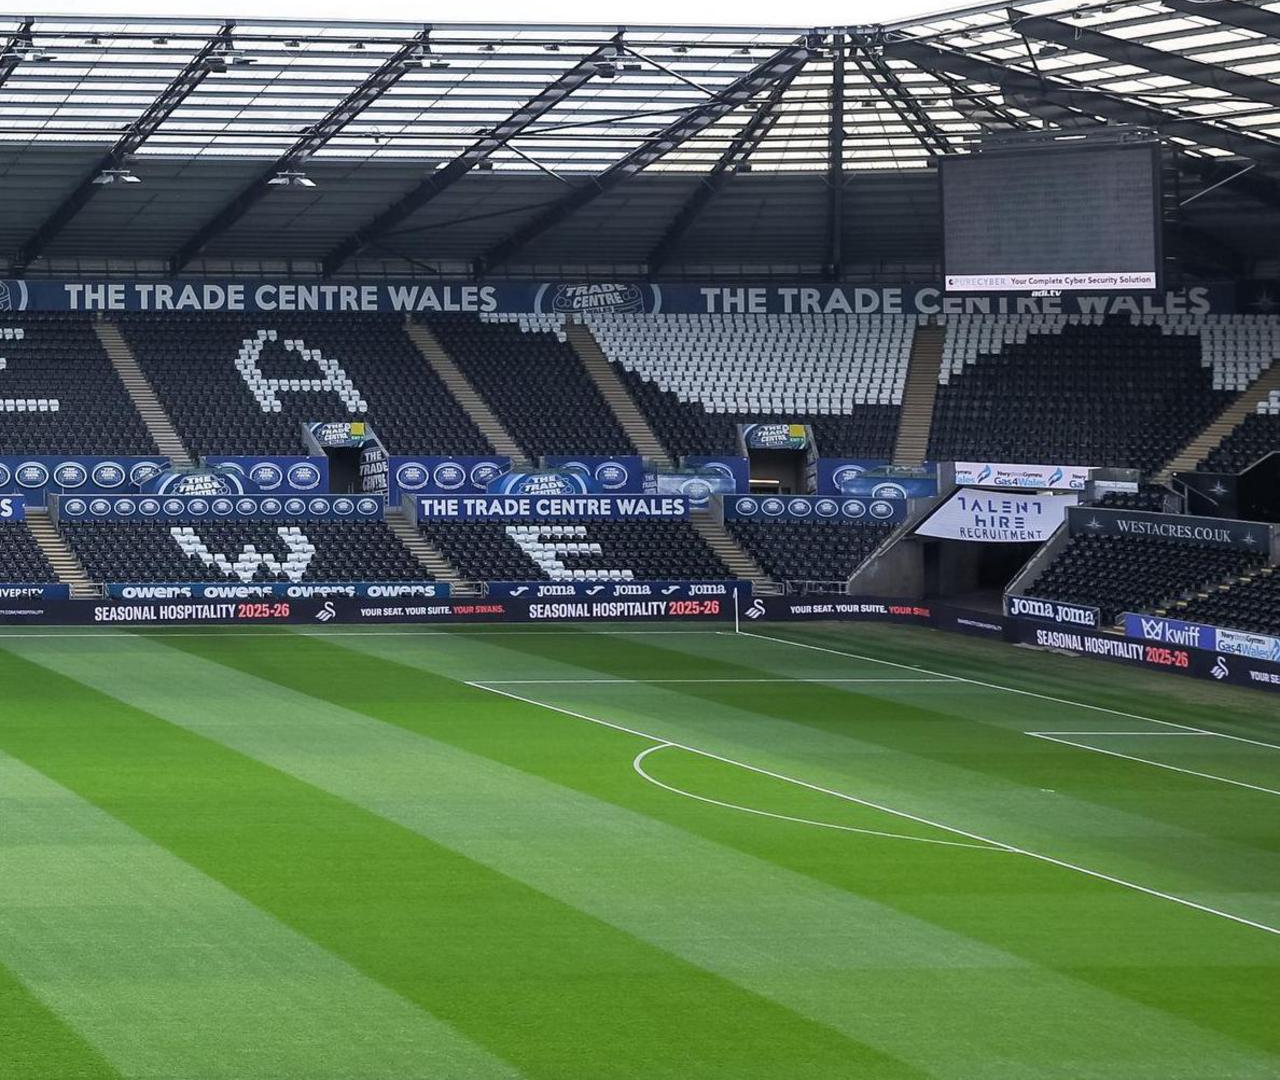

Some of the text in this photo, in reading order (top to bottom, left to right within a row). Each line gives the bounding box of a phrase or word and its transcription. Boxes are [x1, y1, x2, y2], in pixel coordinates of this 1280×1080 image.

[1029, 277, 1062, 286] Complete
[1065, 277, 1086, 286] Cyber
[1088, 277, 1117, 285] Security
[1120, 276, 1151, 284] Solution
[65, 285, 497, 312] THE TRADE CENTRE WALES
[566, 284, 627, 297] TRADE
[572, 293, 623, 309] CENTRE
[700, 288, 766, 312] THE
[778, 288, 902, 313] TRADE
[421, 498, 684, 516] THE TRADE CENTRE WALES
[975, 514, 1024, 529] HIRE
[960, 527, 1042, 540] RECRUITMENT
[1117, 520, 1231, 542] WESTACRES.CO.UK
[122, 587, 192, 598] owens
[95, 604, 289, 620] SEASONAL HOSPITALITY 2025-26
[361, 606, 452, 616] YOUR SEAT. YOUR SUITE.
[529, 600, 719, 618] SEASONAL HOSPITALITY 2025-26
[790, 604, 887, 614] YOUR SEAT. YOUR SUITE.
[1166, 623, 1200, 647] kwiff
[1037, 630, 1189, 668] SEASONAL HOSPITALITY 2025-26
